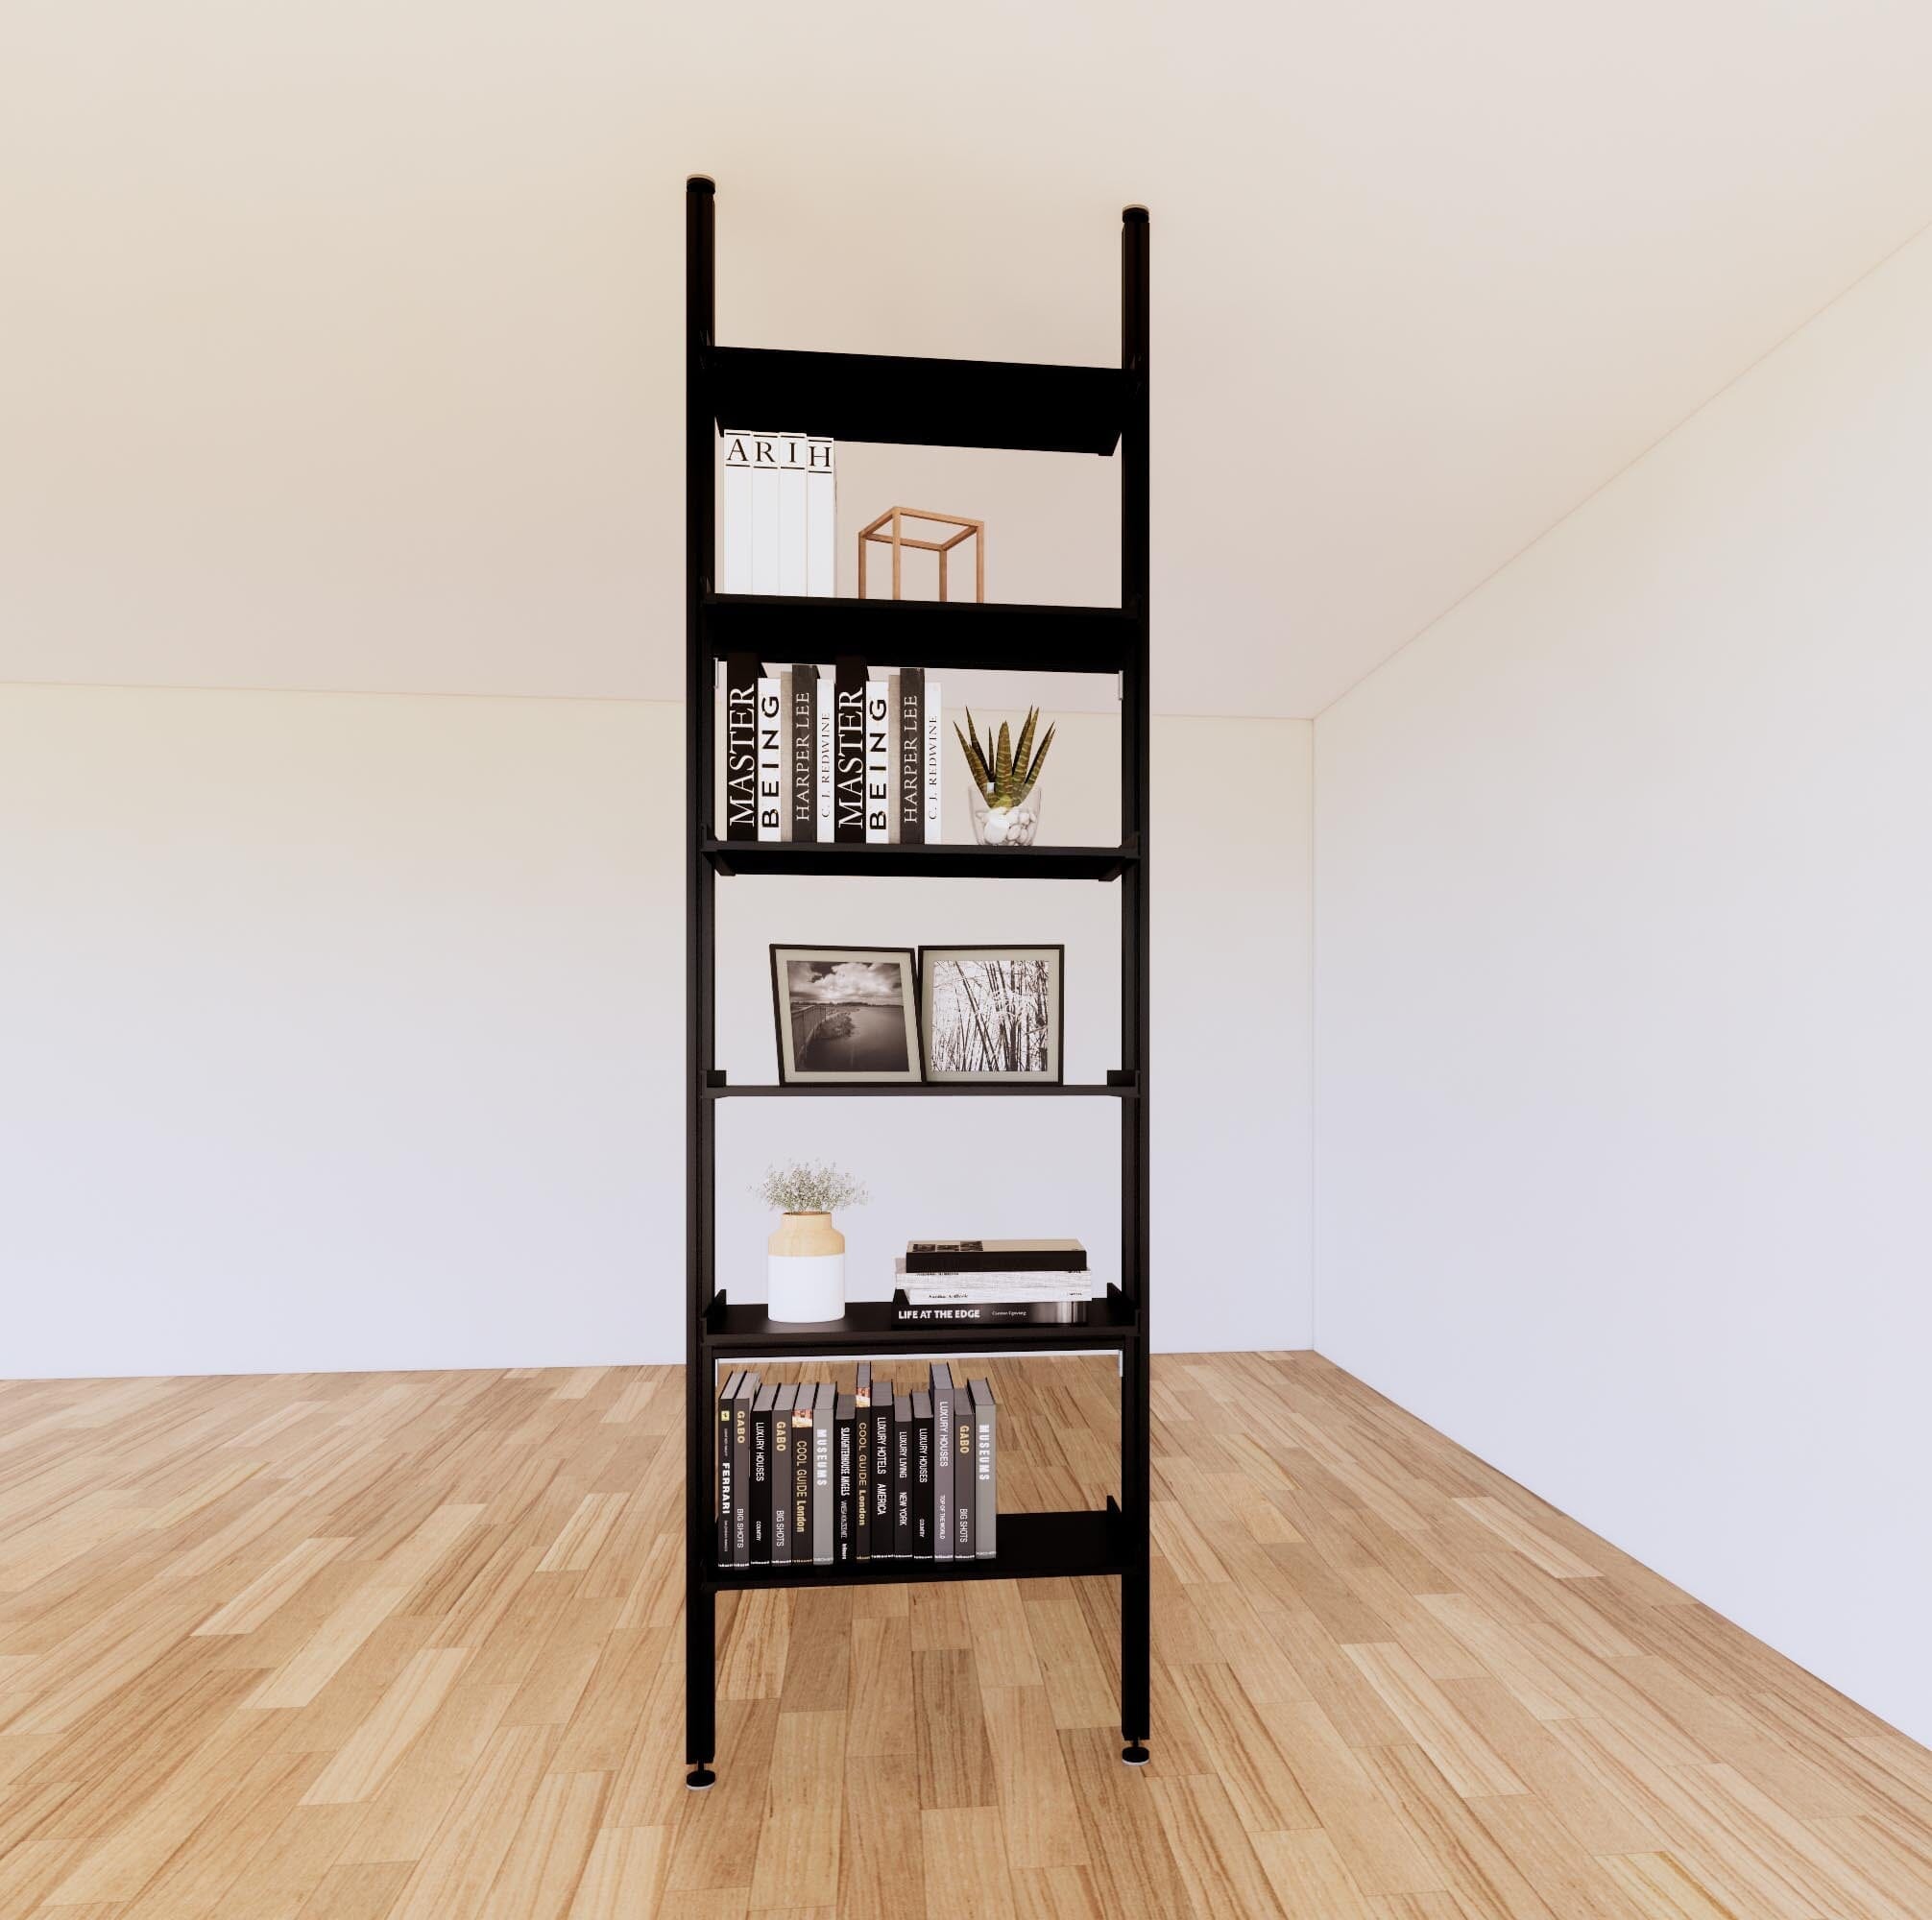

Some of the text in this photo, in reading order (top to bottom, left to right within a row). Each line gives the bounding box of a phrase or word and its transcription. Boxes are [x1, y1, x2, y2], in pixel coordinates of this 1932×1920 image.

[729, 684, 754, 828] MASTER
[761, 696, 779, 828] BEING
[796, 692, 809, 821] HARPER LEE
[821, 713, 831, 783] REDWINE
[837, 686, 863, 829] MASTER
[869, 699, 886, 830] BEING
[904, 695, 917, 823] HARPER LEE
[929, 715, 937, 785] REDWINE
[898, 1309, 980, 1319] LIFE AT THE EDGE
[737, 1410, 745, 1444] GABO
[756, 1422, 764, 1452] LUXURY
[899, 1431, 907, 1457] LUXURY
[919, 1428, 928, 1453] LUXURY
[939, 1402, 949, 1435] LUXURY
[756, 1452, 764, 1482] HOUSES
[816, 1428, 828, 1486] MUSEUMS
[840, 1427, 851, 1475] SLAUGHTERHOUSE
[858, 1422, 867, 1525] COOL GUIDE London
[877, 1417, 887, 1515] LUXURY HOTELS AMERICA
[919, 1453, 928, 1483] HOUSES
[939, 1436, 949, 1467] HOUSES
[978, 1424, 990, 1480] MUSEUMS
[722, 1462, 731, 1514] FERRARI
[776, 1421, 786, 1547] GABO BIG SHOTS
[796, 1440, 807, 1533] COOL GUIDE London
[840, 1476, 851, 1497] ANGELS
[899, 1492, 907, 1506] NEW
[959, 1425, 970, 1543] GABO BIG SHOTS
[899, 1506, 907, 1526] YORK
